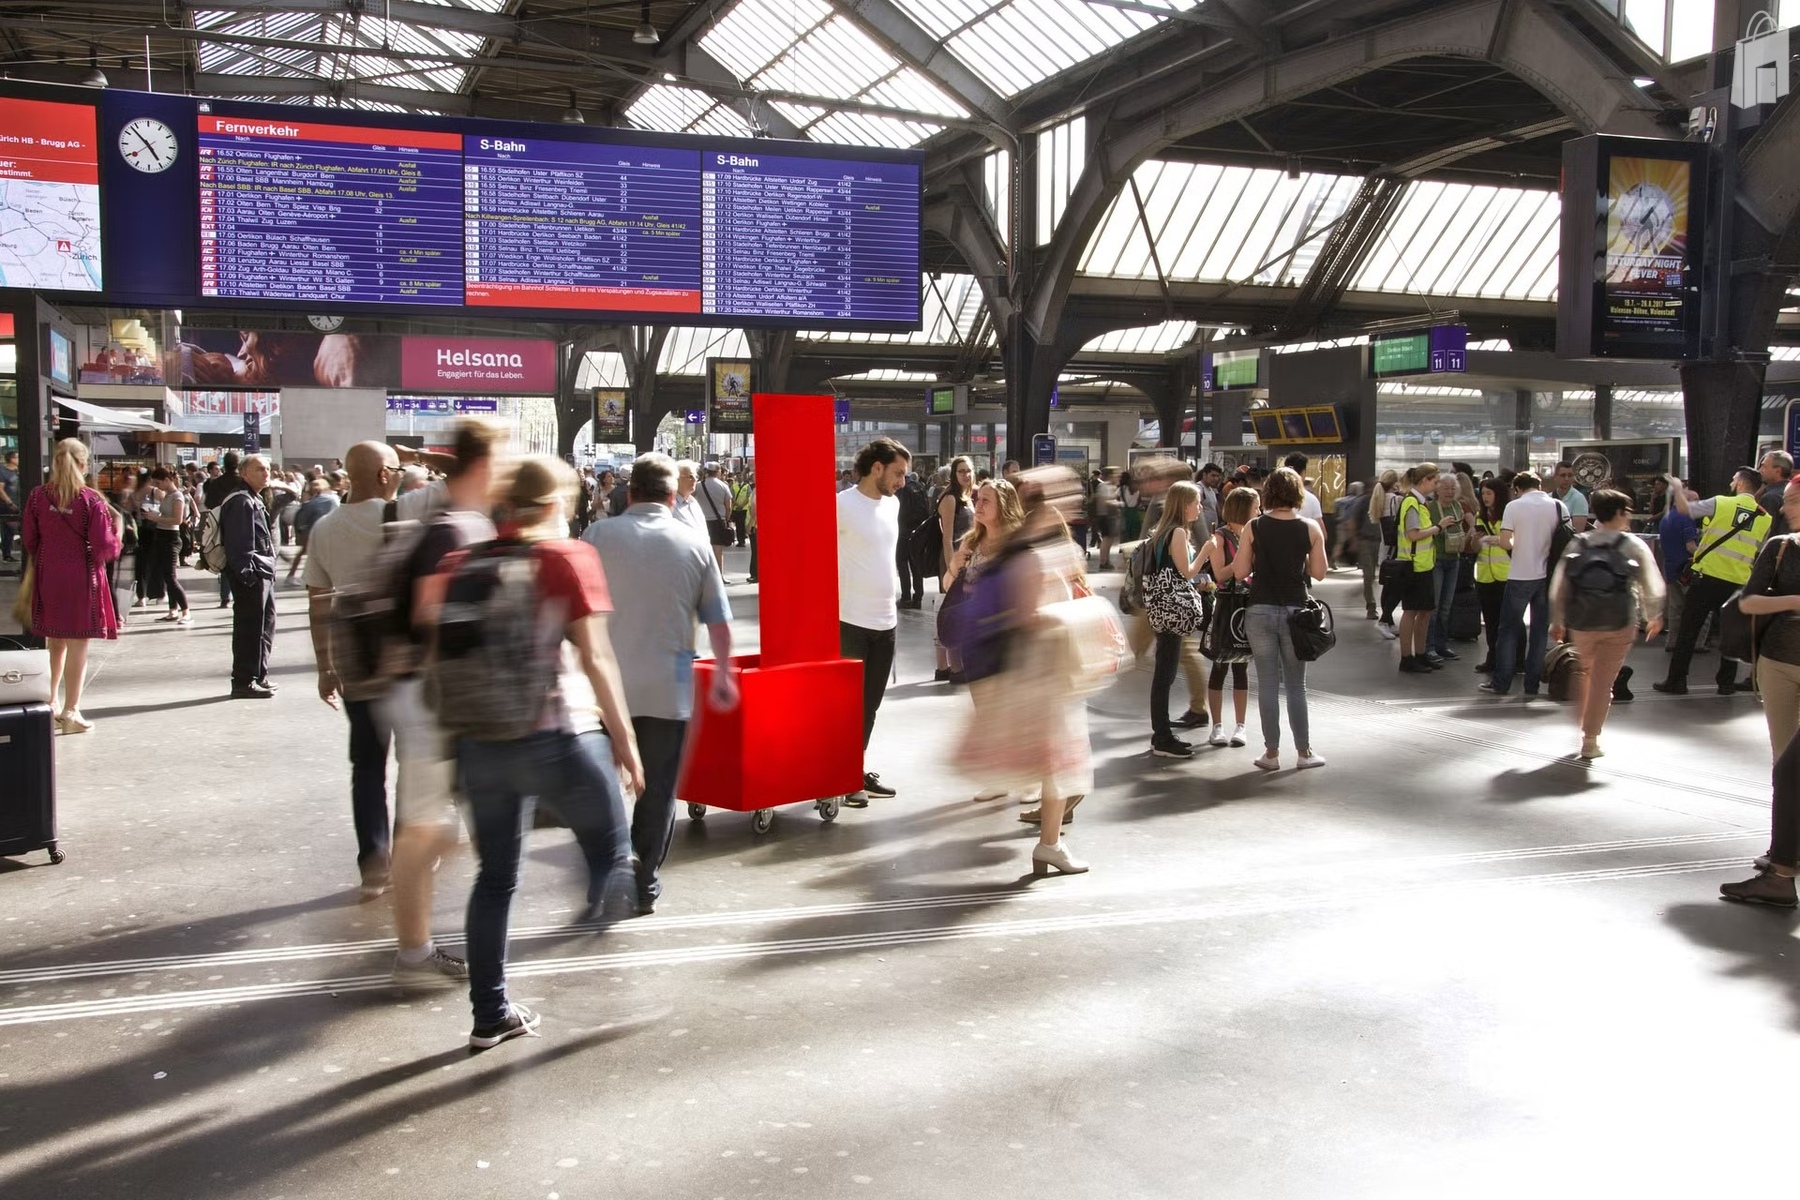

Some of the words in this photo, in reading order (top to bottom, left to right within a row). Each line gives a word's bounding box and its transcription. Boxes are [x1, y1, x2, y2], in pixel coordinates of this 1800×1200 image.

[216, 120, 299, 137] Fernverkehr
[41, 139, 65, 148] Brugg
[481, 140, 526, 152] S-Bahn
[264, 153, 294, 161] Flughafen
[717, 155, 758, 167] S-Bahn
[1607, 257, 1652, 267] SATURDAY
[1655, 260, 1681, 269] NIGHT
[1630, 270, 1658, 279] FEVER
[437, 349, 523, 367] Helsana
[1435, 358, 1442, 368] 11
[1451, 358, 1460, 368] 11
[437, 370, 472, 380] Engagiert
[1203, 380, 1210, 389] 10
